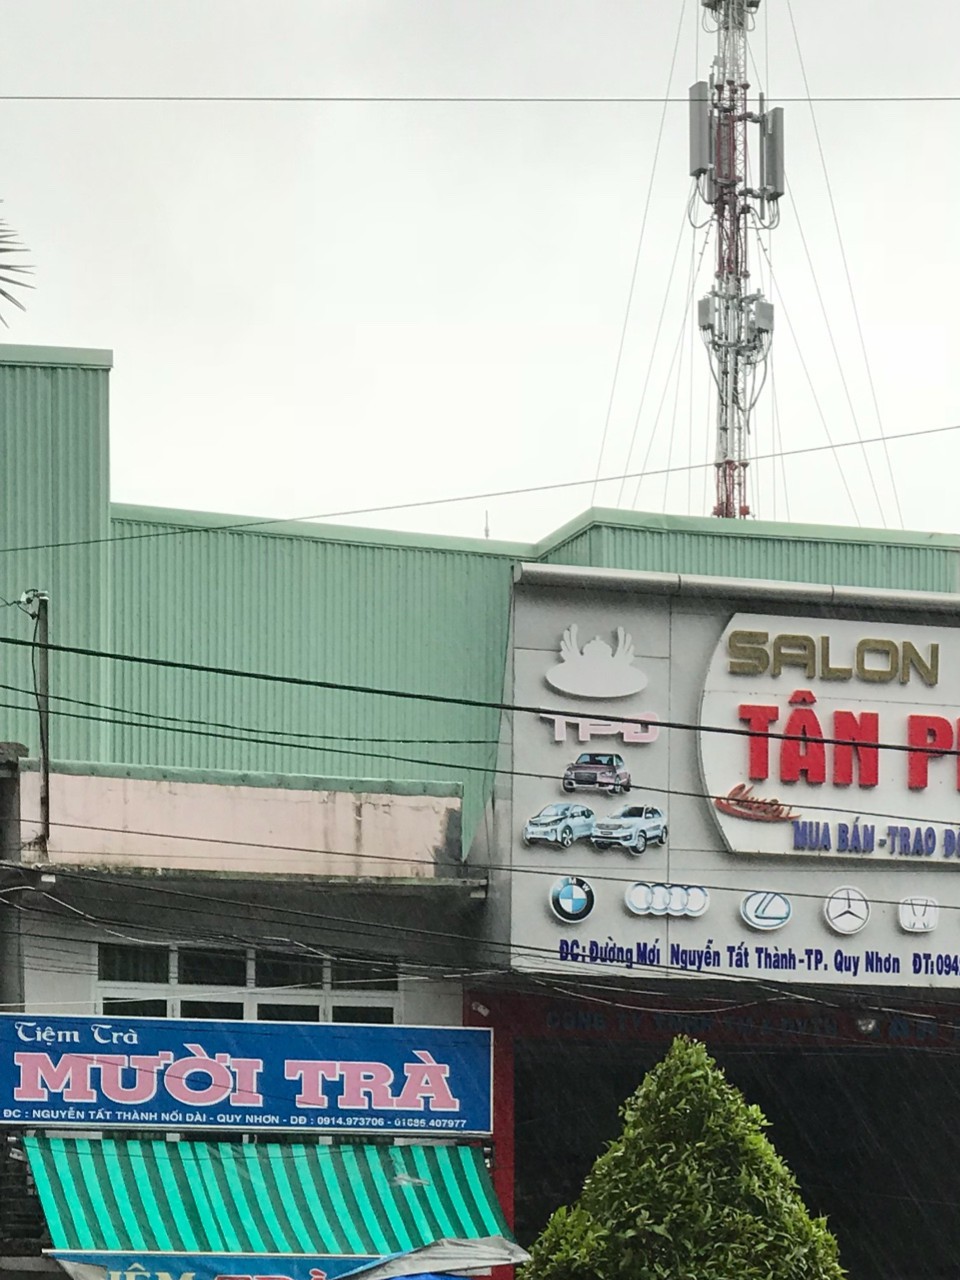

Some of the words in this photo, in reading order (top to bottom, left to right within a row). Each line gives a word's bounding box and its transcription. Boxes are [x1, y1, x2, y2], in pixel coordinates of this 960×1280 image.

[728, 630, 940, 687] SALON
[738, 690, 879, 788] TÂN
[793, 820, 831, 852] MUA
[836, 816, 876, 854] BÁN
[636, 938, 661, 966] Mới
[670, 938, 721, 970] Nguyễn
[727, 941, 749, 968] Tất
[834, 949, 860, 977] Quy
[865, 951, 900, 974] Nhơn
[14, 1021, 80, 1046] Tiệm
[91, 1023, 138, 1045] Trà
[14, 1043, 263, 1107] MƯỜI
[284, 1050, 460, 1112] TRÀ
[32, 1107, 85, 1120] NGUYỄN
[90, 1107, 111, 1120] TẤT
[115, 1108, 158, 1121] THÀNH
[161, 1108, 183, 1122] NỐI
[186, 1109, 207, 1122] DÀI
[217, 1113, 242, 1123] QUY
[246, 1114, 279, 1124] NHƠN
